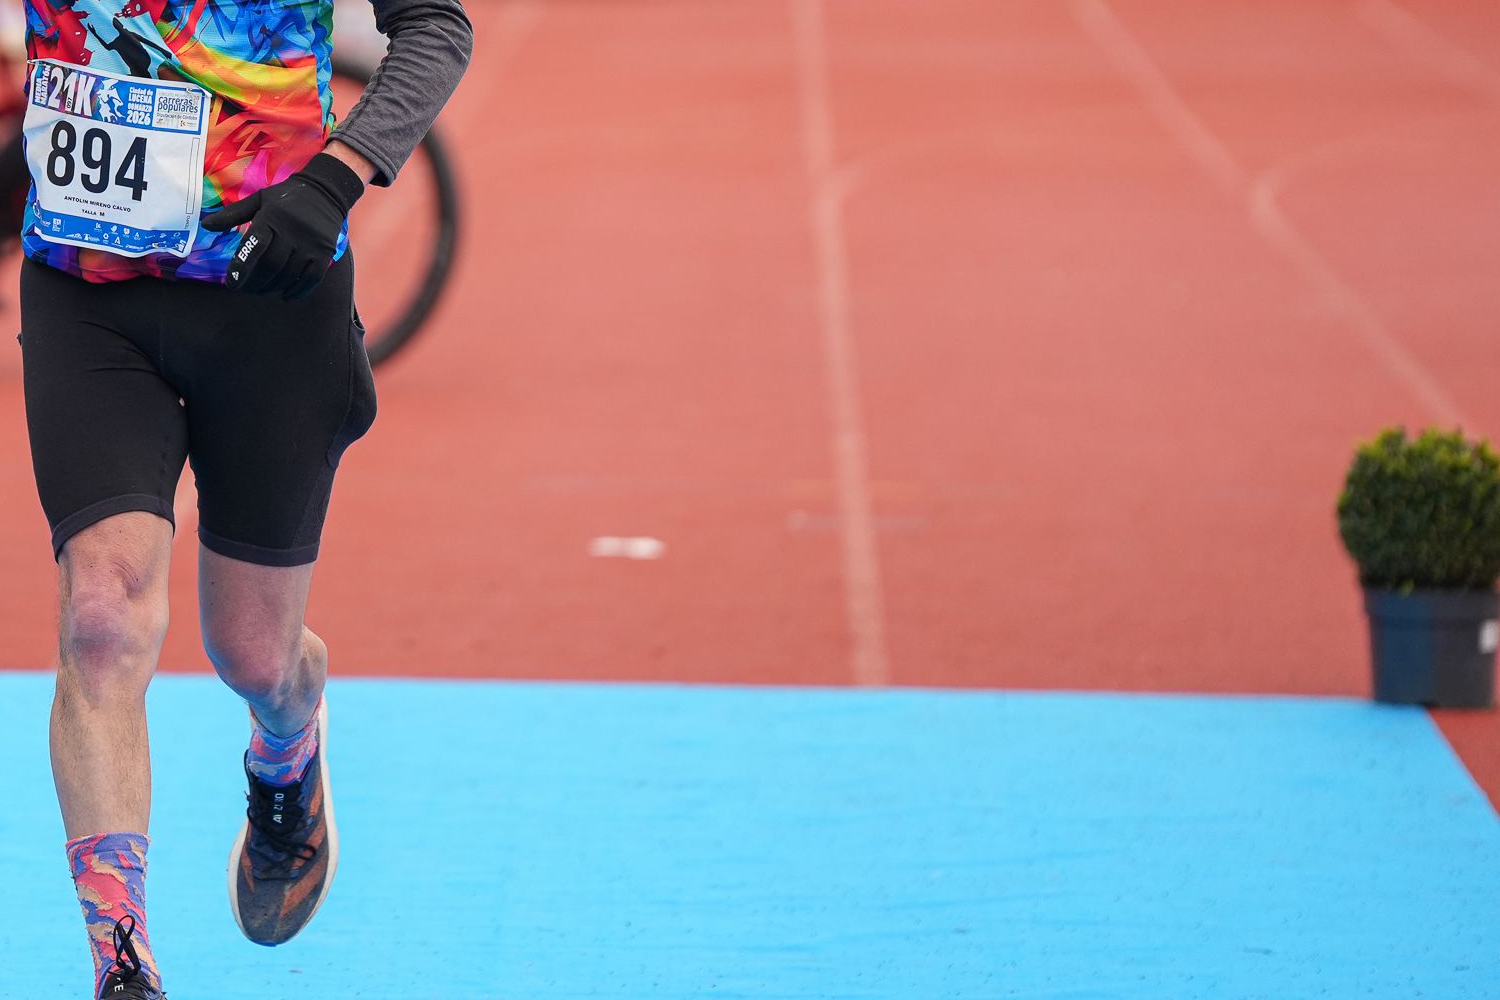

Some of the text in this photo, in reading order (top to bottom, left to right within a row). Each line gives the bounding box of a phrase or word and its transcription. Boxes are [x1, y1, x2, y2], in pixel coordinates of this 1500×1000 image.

[34, 77, 42, 103] MEDIA
[47, 66, 96, 117] 21K
[128, 93, 153, 105] LUCENA
[157, 101, 199, 114] populares
[158, 96, 193, 106] carreras
[126, 109, 151, 126] 2026
[46, 120, 148, 202] 894
[64, 195, 88, 204] ANTOLIN
[112, 204, 131, 213] CALVO
[237, 235, 259, 262] ERRE
